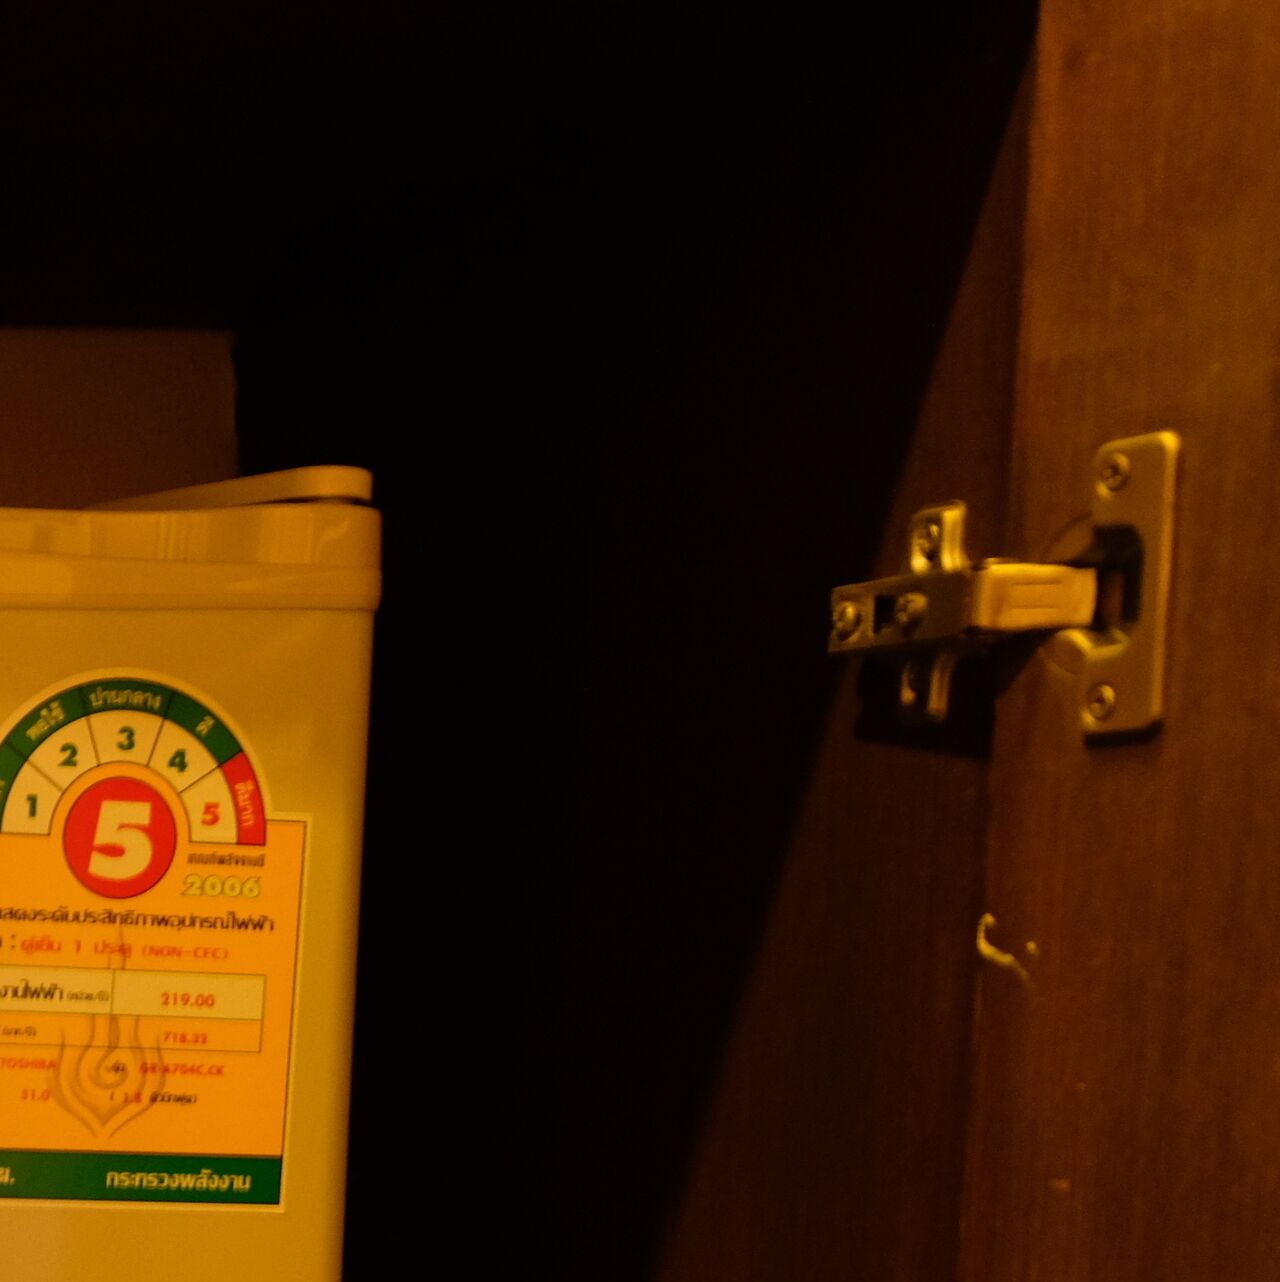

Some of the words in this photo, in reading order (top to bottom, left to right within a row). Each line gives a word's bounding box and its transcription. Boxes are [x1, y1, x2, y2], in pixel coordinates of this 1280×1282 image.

[117, 726, 135, 751] 3
[58, 743, 78, 767] 2
[168, 749, 187, 773] 4
[26, 794, 37, 818] 1
[201, 802, 220, 826] 5
[88, 800, 153, 880] 5
[182, 873, 261, 898] 2006
[161, 992, 215, 1008] 219.00
[106, 1169, 252, 1192] กระทรวงพลังงาน
